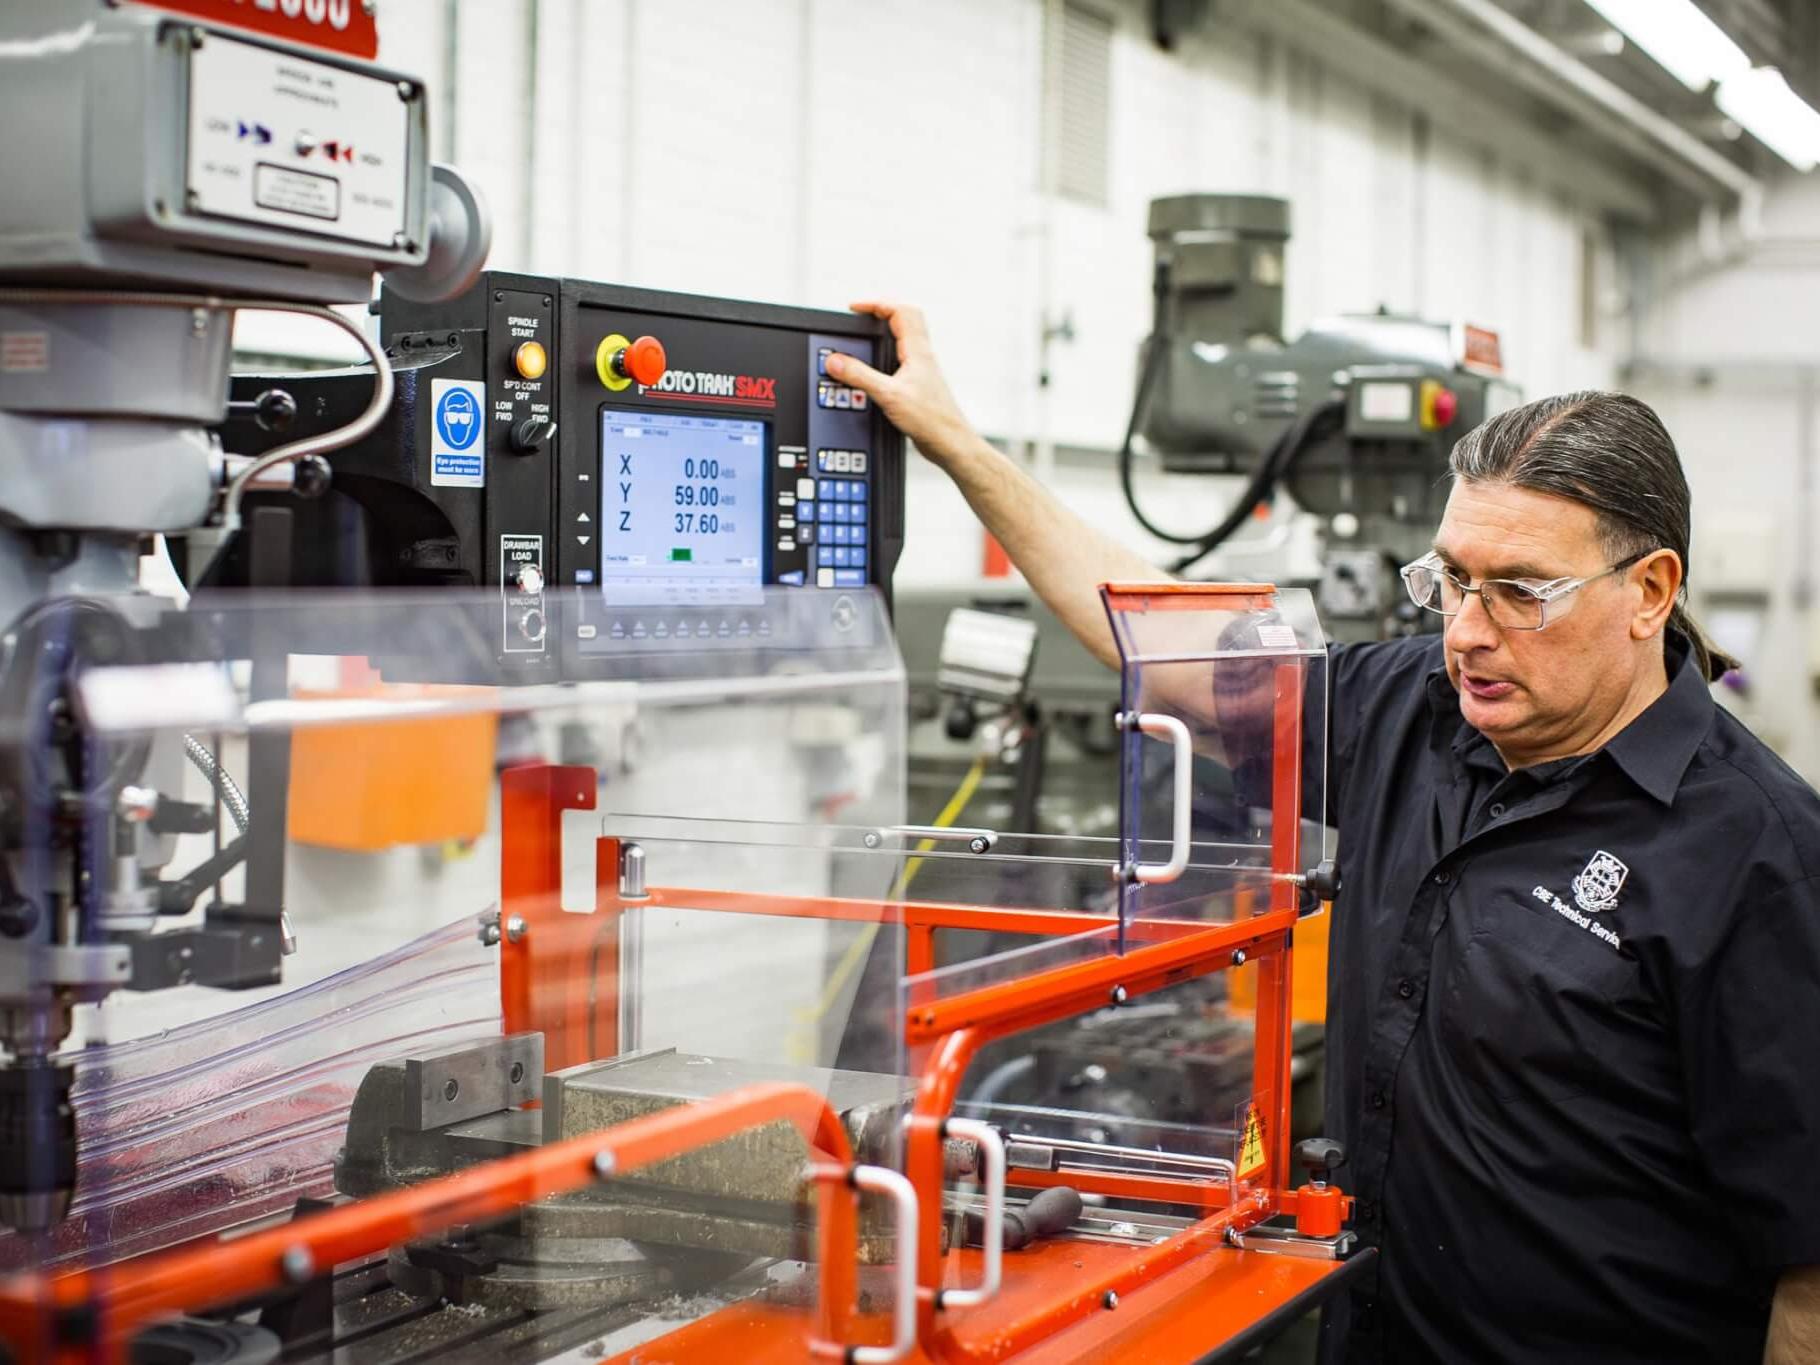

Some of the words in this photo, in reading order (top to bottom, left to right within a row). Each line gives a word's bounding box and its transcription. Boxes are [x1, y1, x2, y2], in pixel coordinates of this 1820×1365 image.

[253, 0, 350, 30] 00
[507, 316, 539, 328] SPINDLE
[511, 328, 534, 337] START
[522, 382, 542, 391] CONT
[735, 376, 776, 400] SMX
[515, 392, 531, 401] OFF
[495, 401, 513, 410] LOW
[531, 403, 550, 413] HIGH
[495, 412, 513, 421] FWD
[532, 414, 549, 424] FWD
[619, 454, 632, 476] X
[684, 457, 719, 480] 0.00
[619, 482, 632, 503] Y
[674, 485, 719, 507] 59.00
[619, 511, 632, 531] Z
[674, 513, 719, 534] 37.60
[504, 540, 540, 550] DRAWBAR
[511, 551, 533, 561] LOAD
[1550, 896, 1592, 930] Technical
